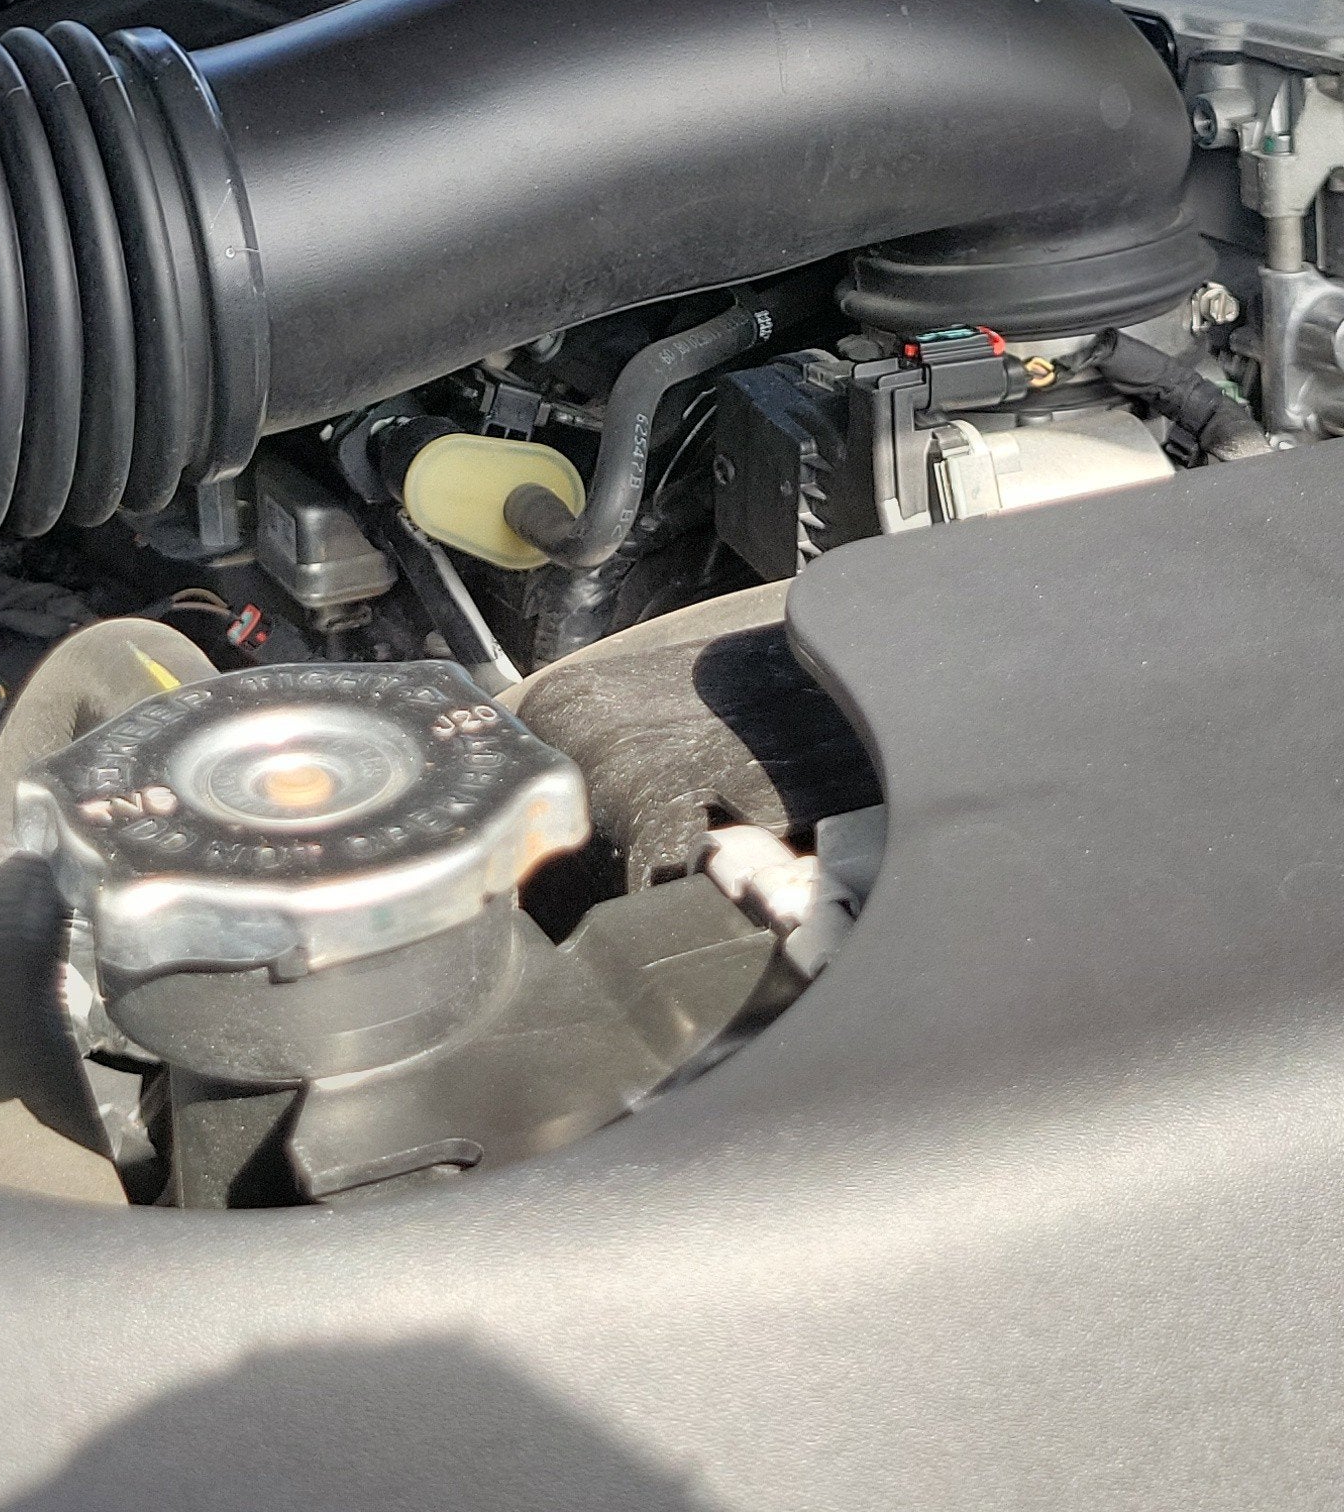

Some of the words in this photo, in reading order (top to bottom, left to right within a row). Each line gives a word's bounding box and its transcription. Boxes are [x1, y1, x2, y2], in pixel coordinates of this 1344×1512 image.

[96, 690, 213, 760] KEEP
[240, 669, 406, 691] TIGHT
[121, 818, 199, 854] DO
[206, 839, 325, 870] NOT
[459, 735, 506, 788] HOT
